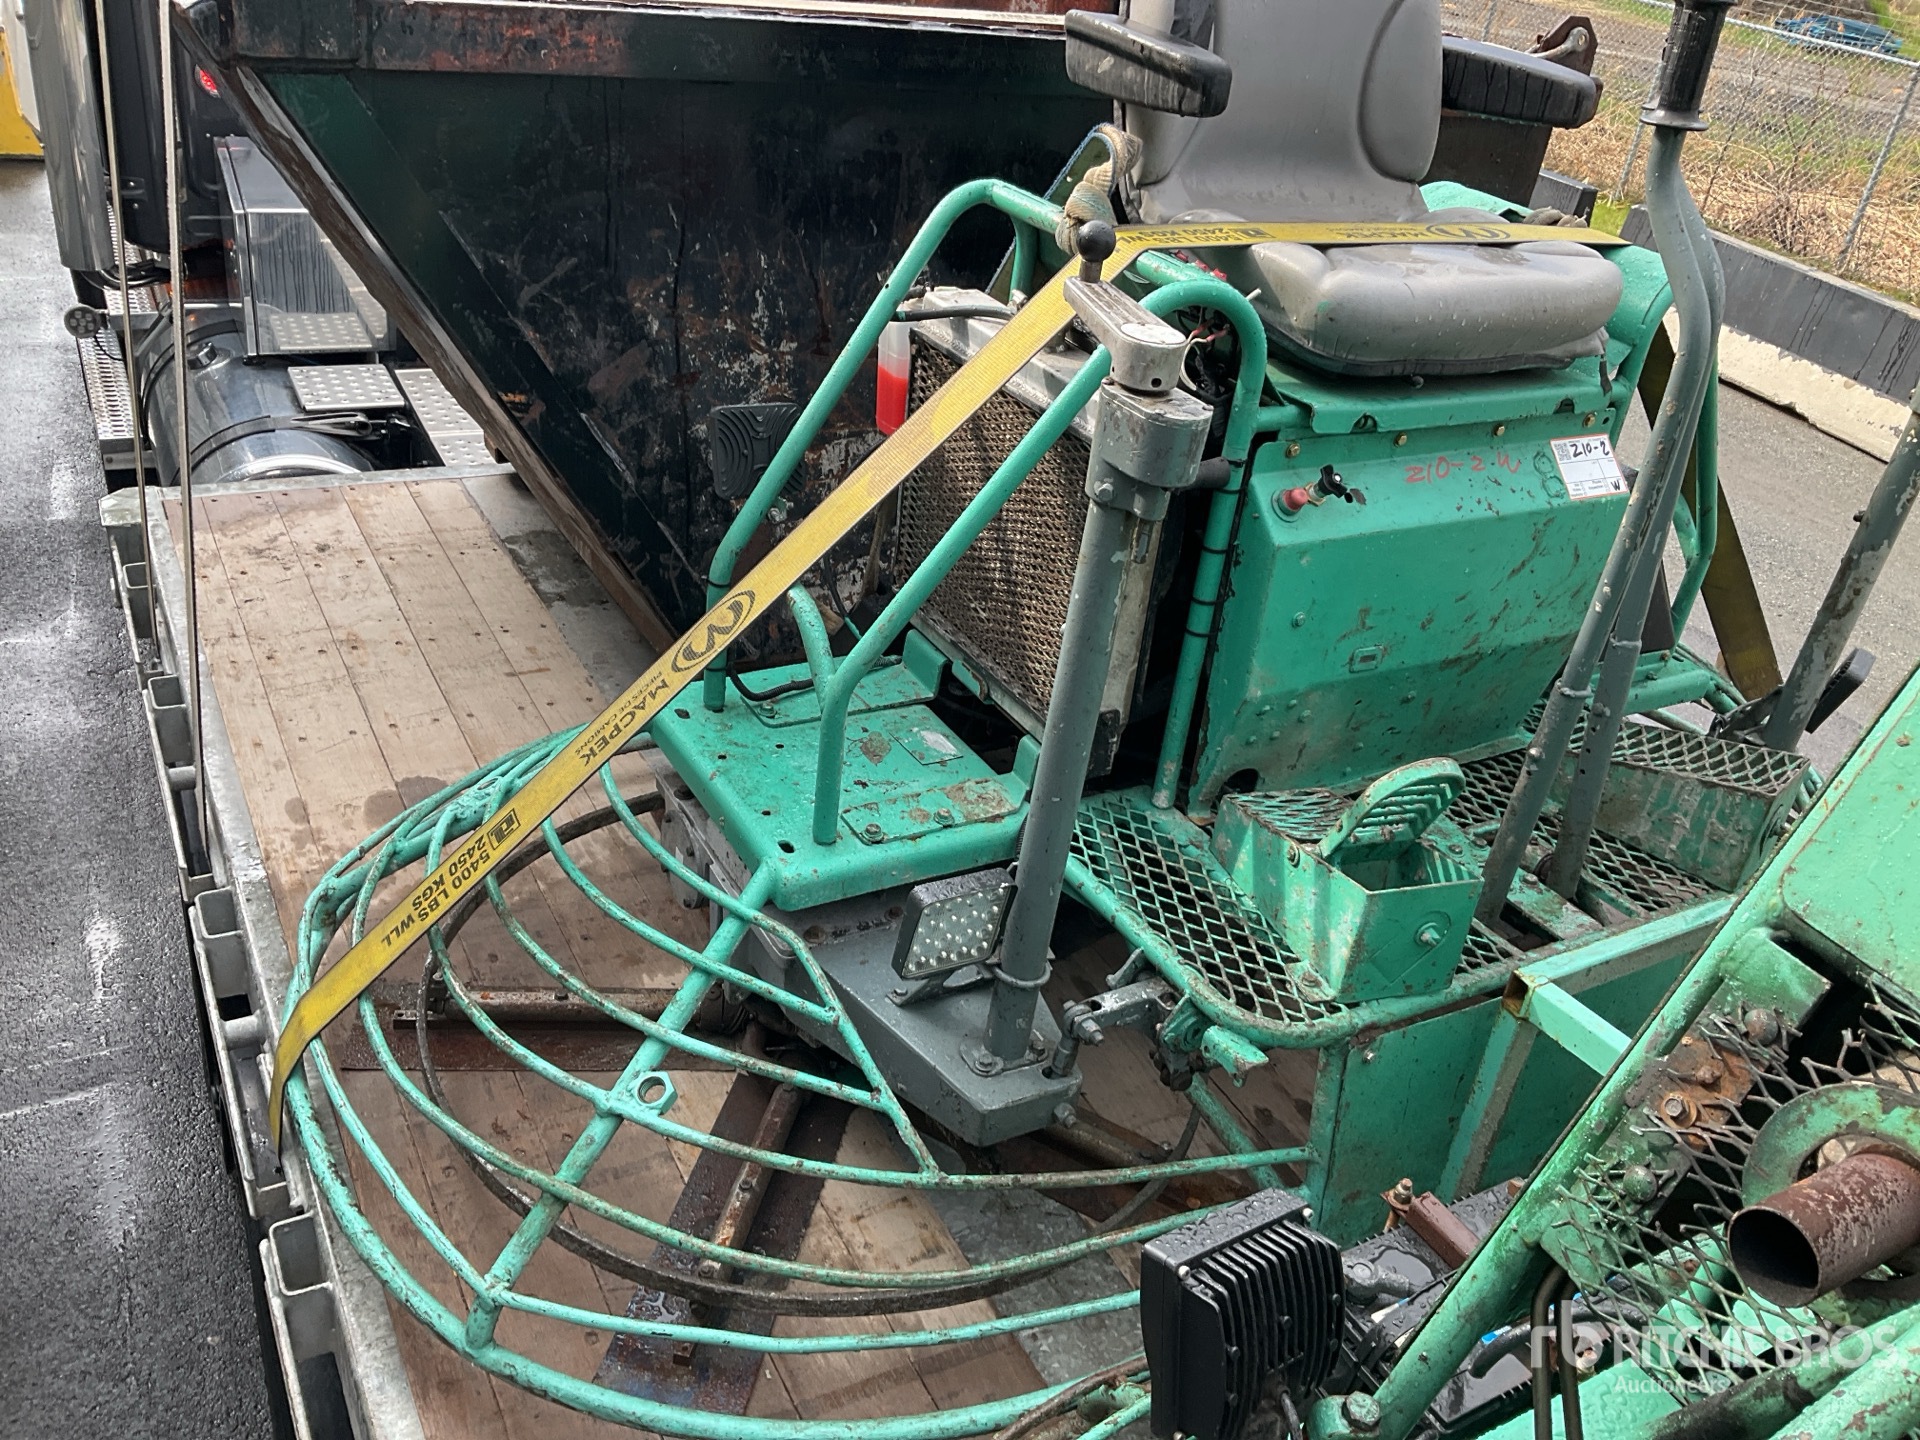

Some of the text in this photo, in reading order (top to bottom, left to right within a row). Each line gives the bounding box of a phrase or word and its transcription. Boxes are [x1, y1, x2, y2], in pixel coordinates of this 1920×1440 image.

[1610, 480, 1621, 491] W
[579, 679, 669, 766] MACPEK
[381, 850, 490, 948] 5400 LBS WLL
[412, 834, 486, 911] 2450 KGS
